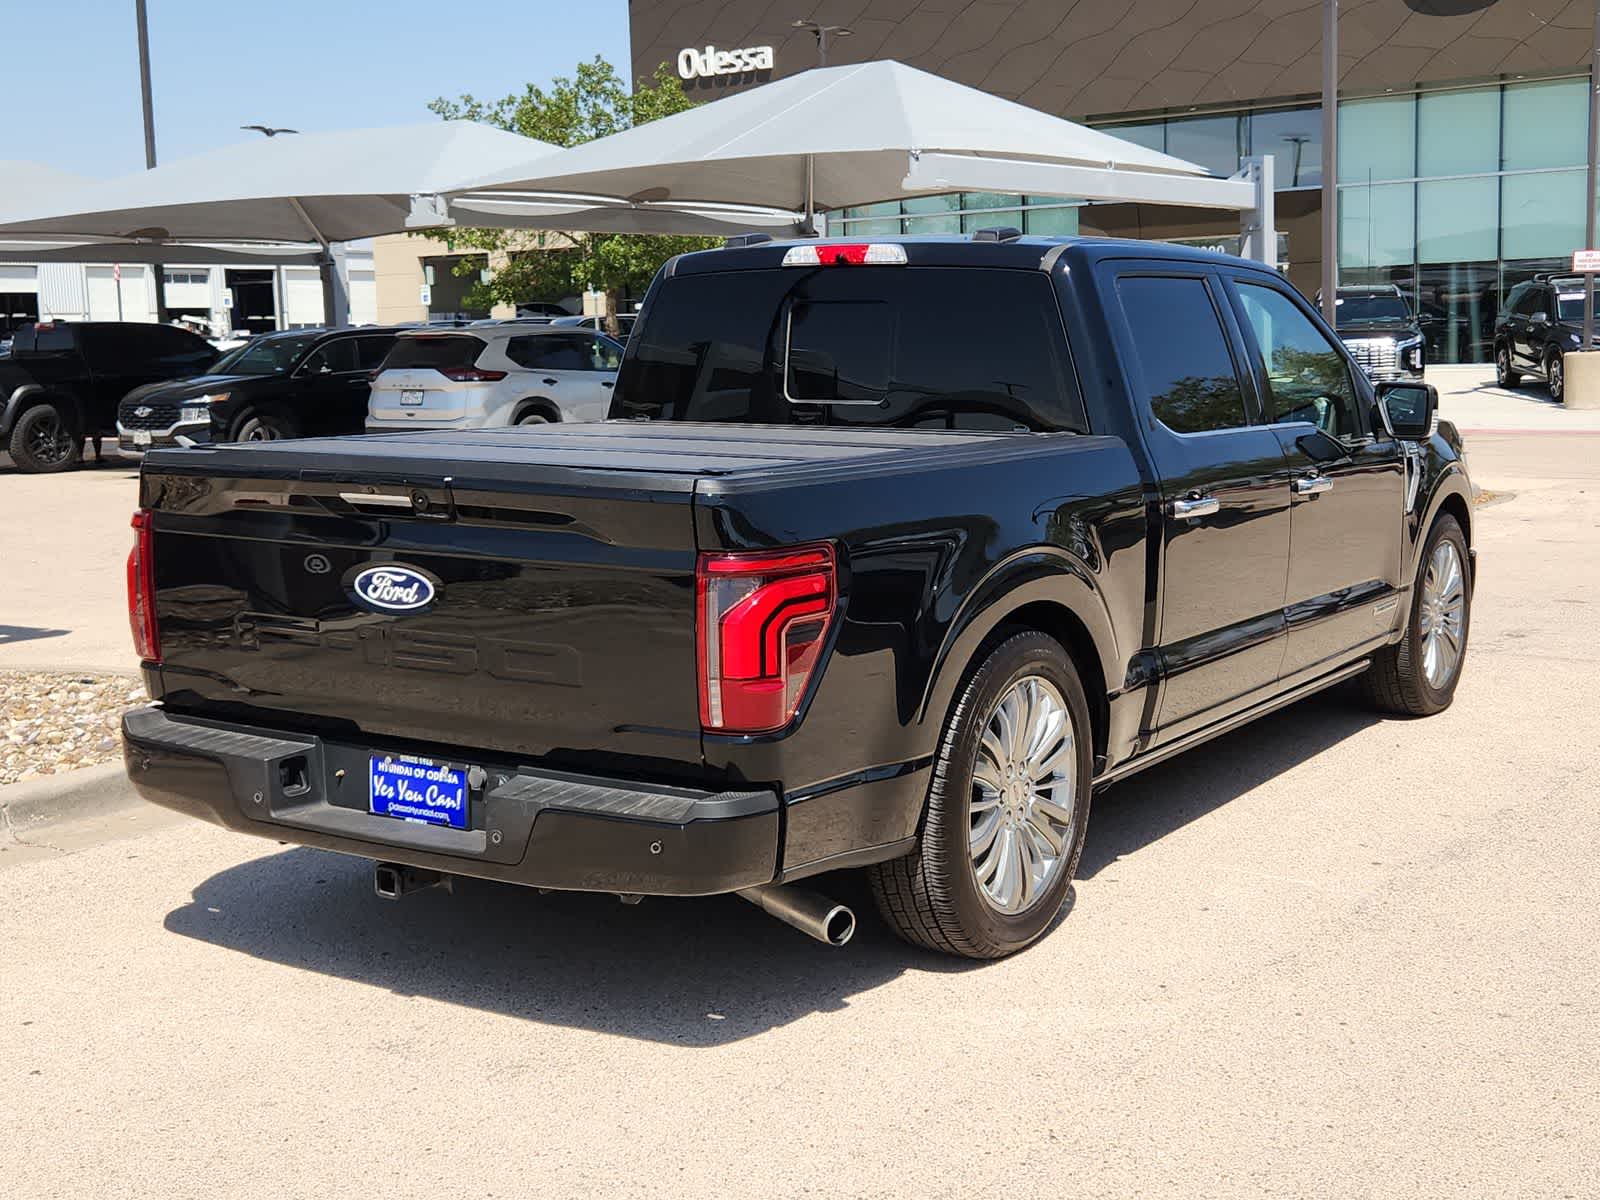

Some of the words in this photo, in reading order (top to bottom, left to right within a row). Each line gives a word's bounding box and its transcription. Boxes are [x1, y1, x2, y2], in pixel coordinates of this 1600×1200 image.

[678, 45, 774, 79] Odessa
[367, 571, 420, 603] Ford
[378, 762, 413, 777] HYUNDAI
[414, 767, 426, 779] OF
[426, 770, 459, 785] ODESA
[373, 775, 395, 799] Yes
[397, 779, 424, 803] You
[425, 784, 462, 810] Can!
